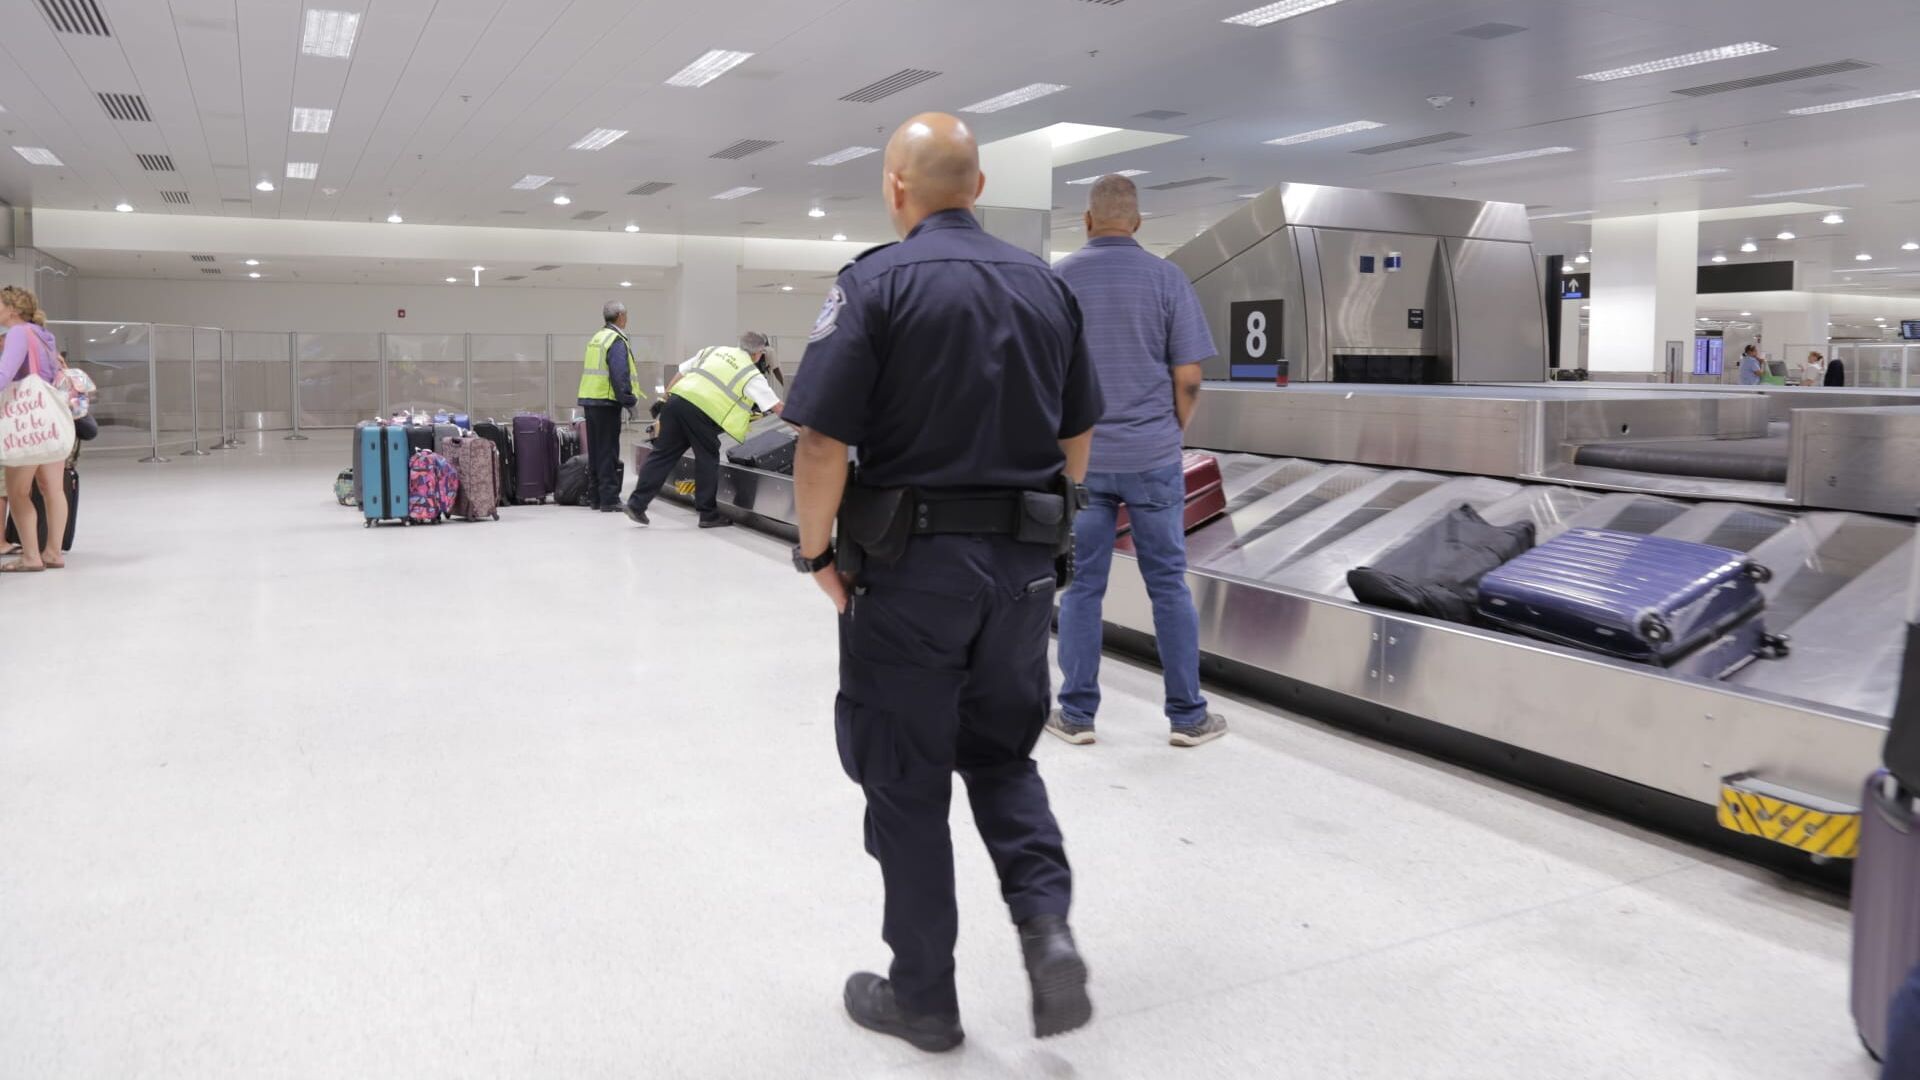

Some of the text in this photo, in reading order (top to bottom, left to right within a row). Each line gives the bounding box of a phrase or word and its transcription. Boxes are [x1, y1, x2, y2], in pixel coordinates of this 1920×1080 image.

[1246, 310, 1267, 358] 8
[12, 387, 32, 401] too
[15, 413, 45, 432] to be
[3, 422, 59, 450] stressed
